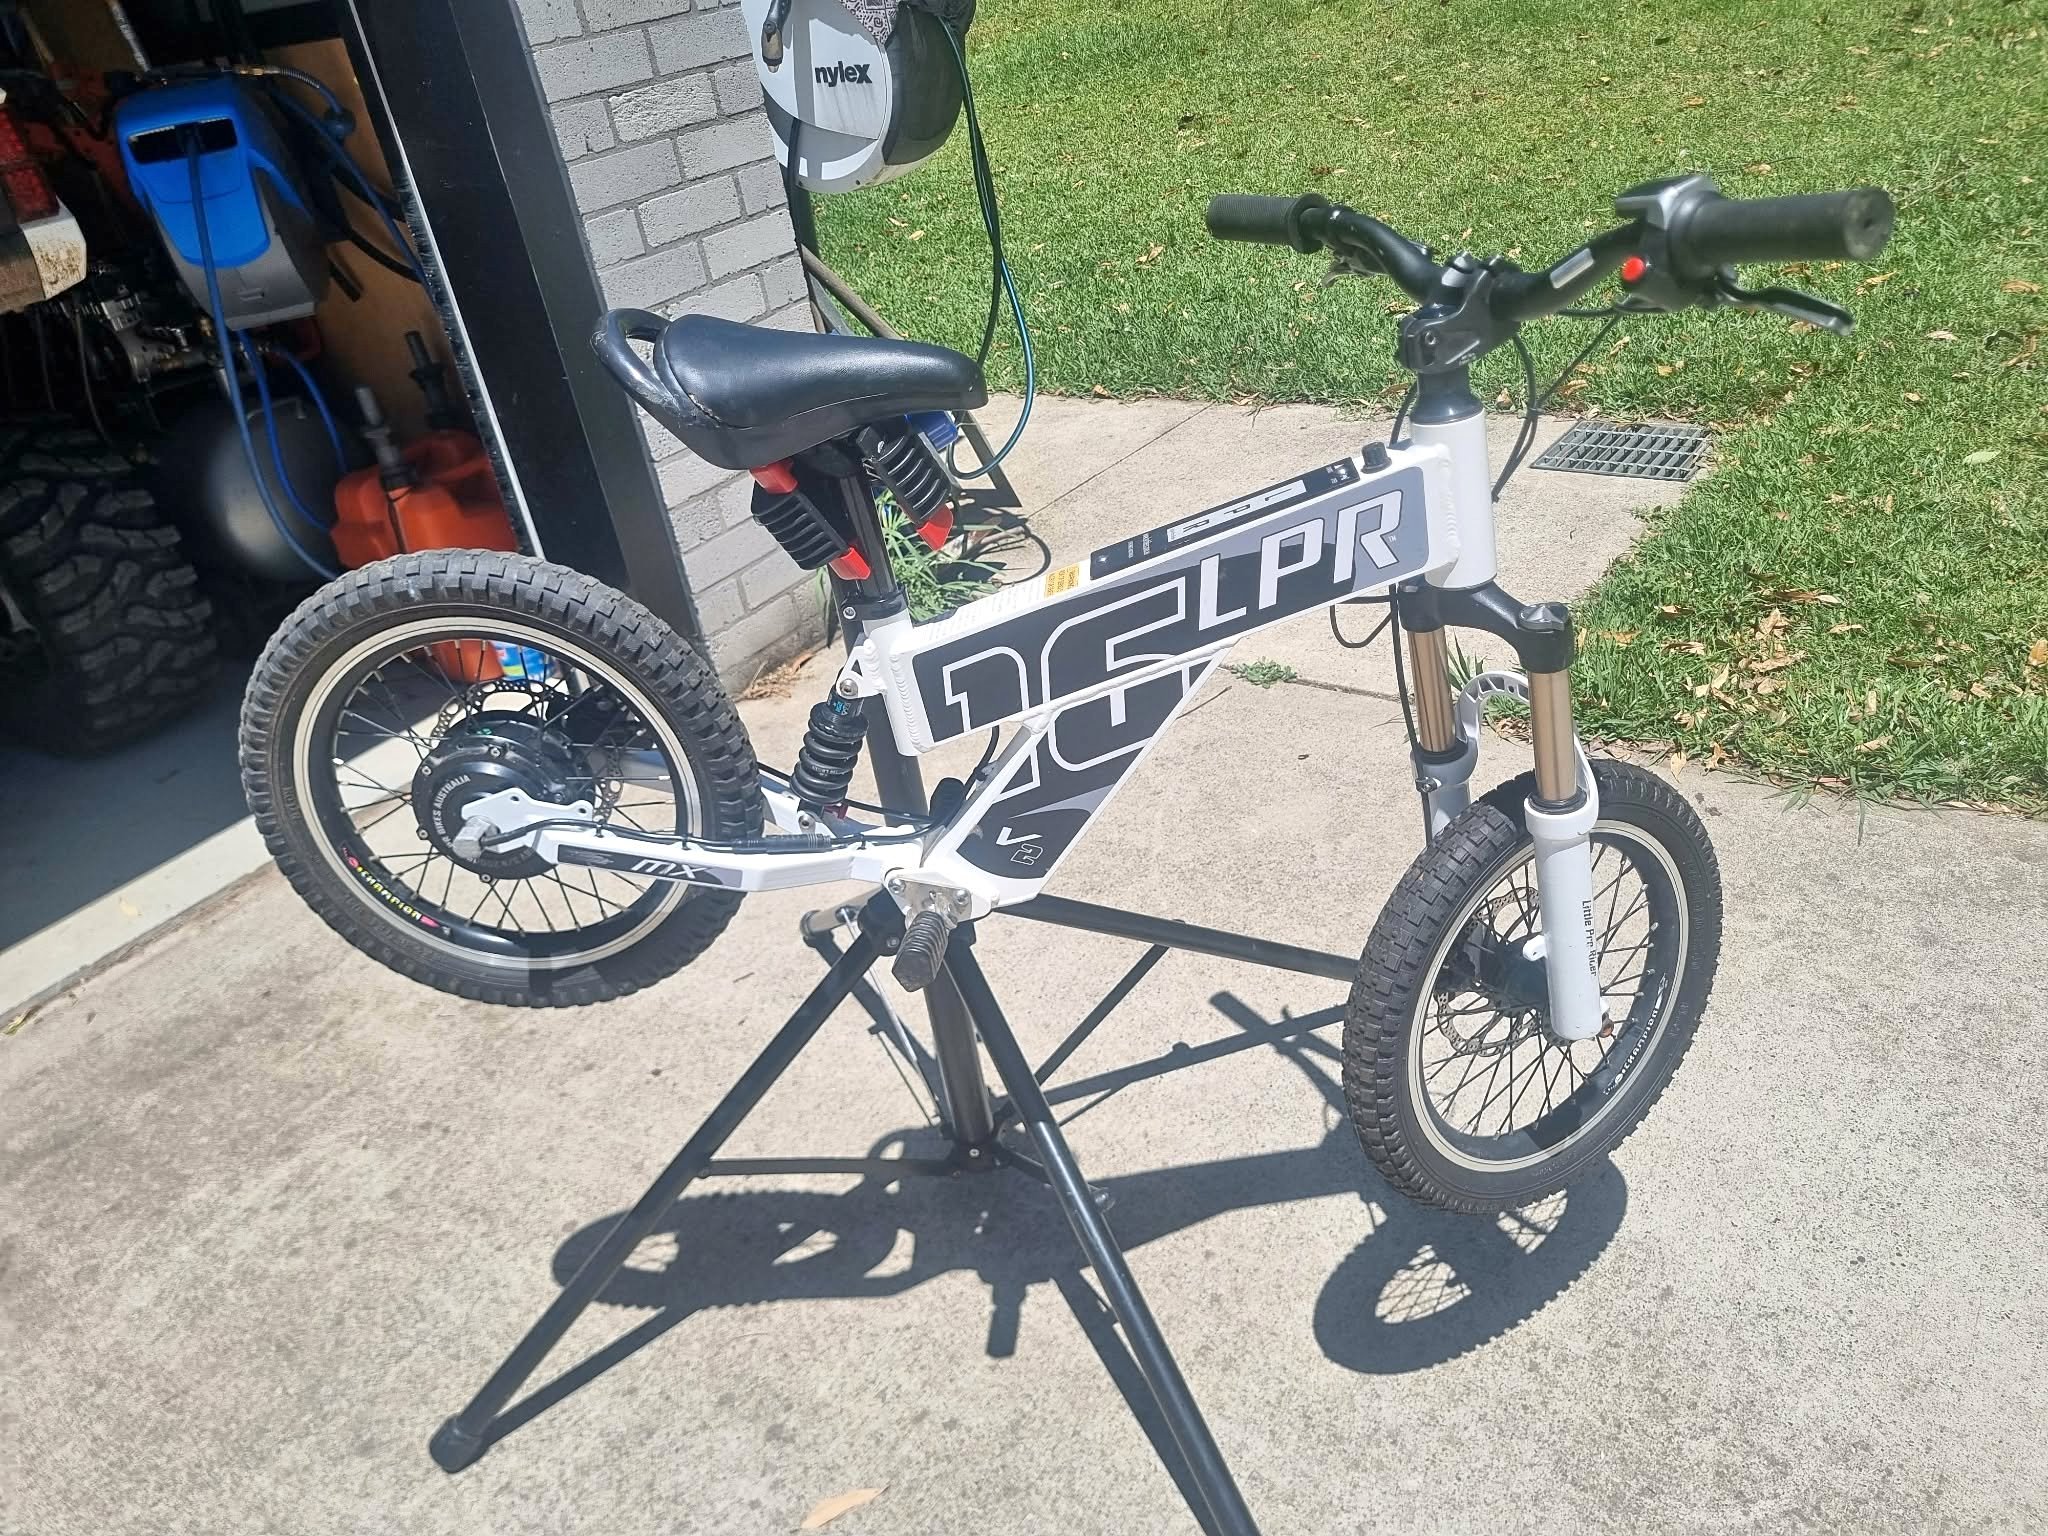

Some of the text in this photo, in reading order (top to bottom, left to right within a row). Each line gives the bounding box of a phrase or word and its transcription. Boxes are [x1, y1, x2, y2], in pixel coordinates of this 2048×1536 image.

[814, 61, 873, 87] nylex
[1199, 490, 1404, 631] LPR
[433, 774, 471, 809] AUSTRALIA
[432, 809, 447, 835] BIKES
[361, 870, 422, 920] CHAMPION
[1582, 900, 1594, 926] Little
